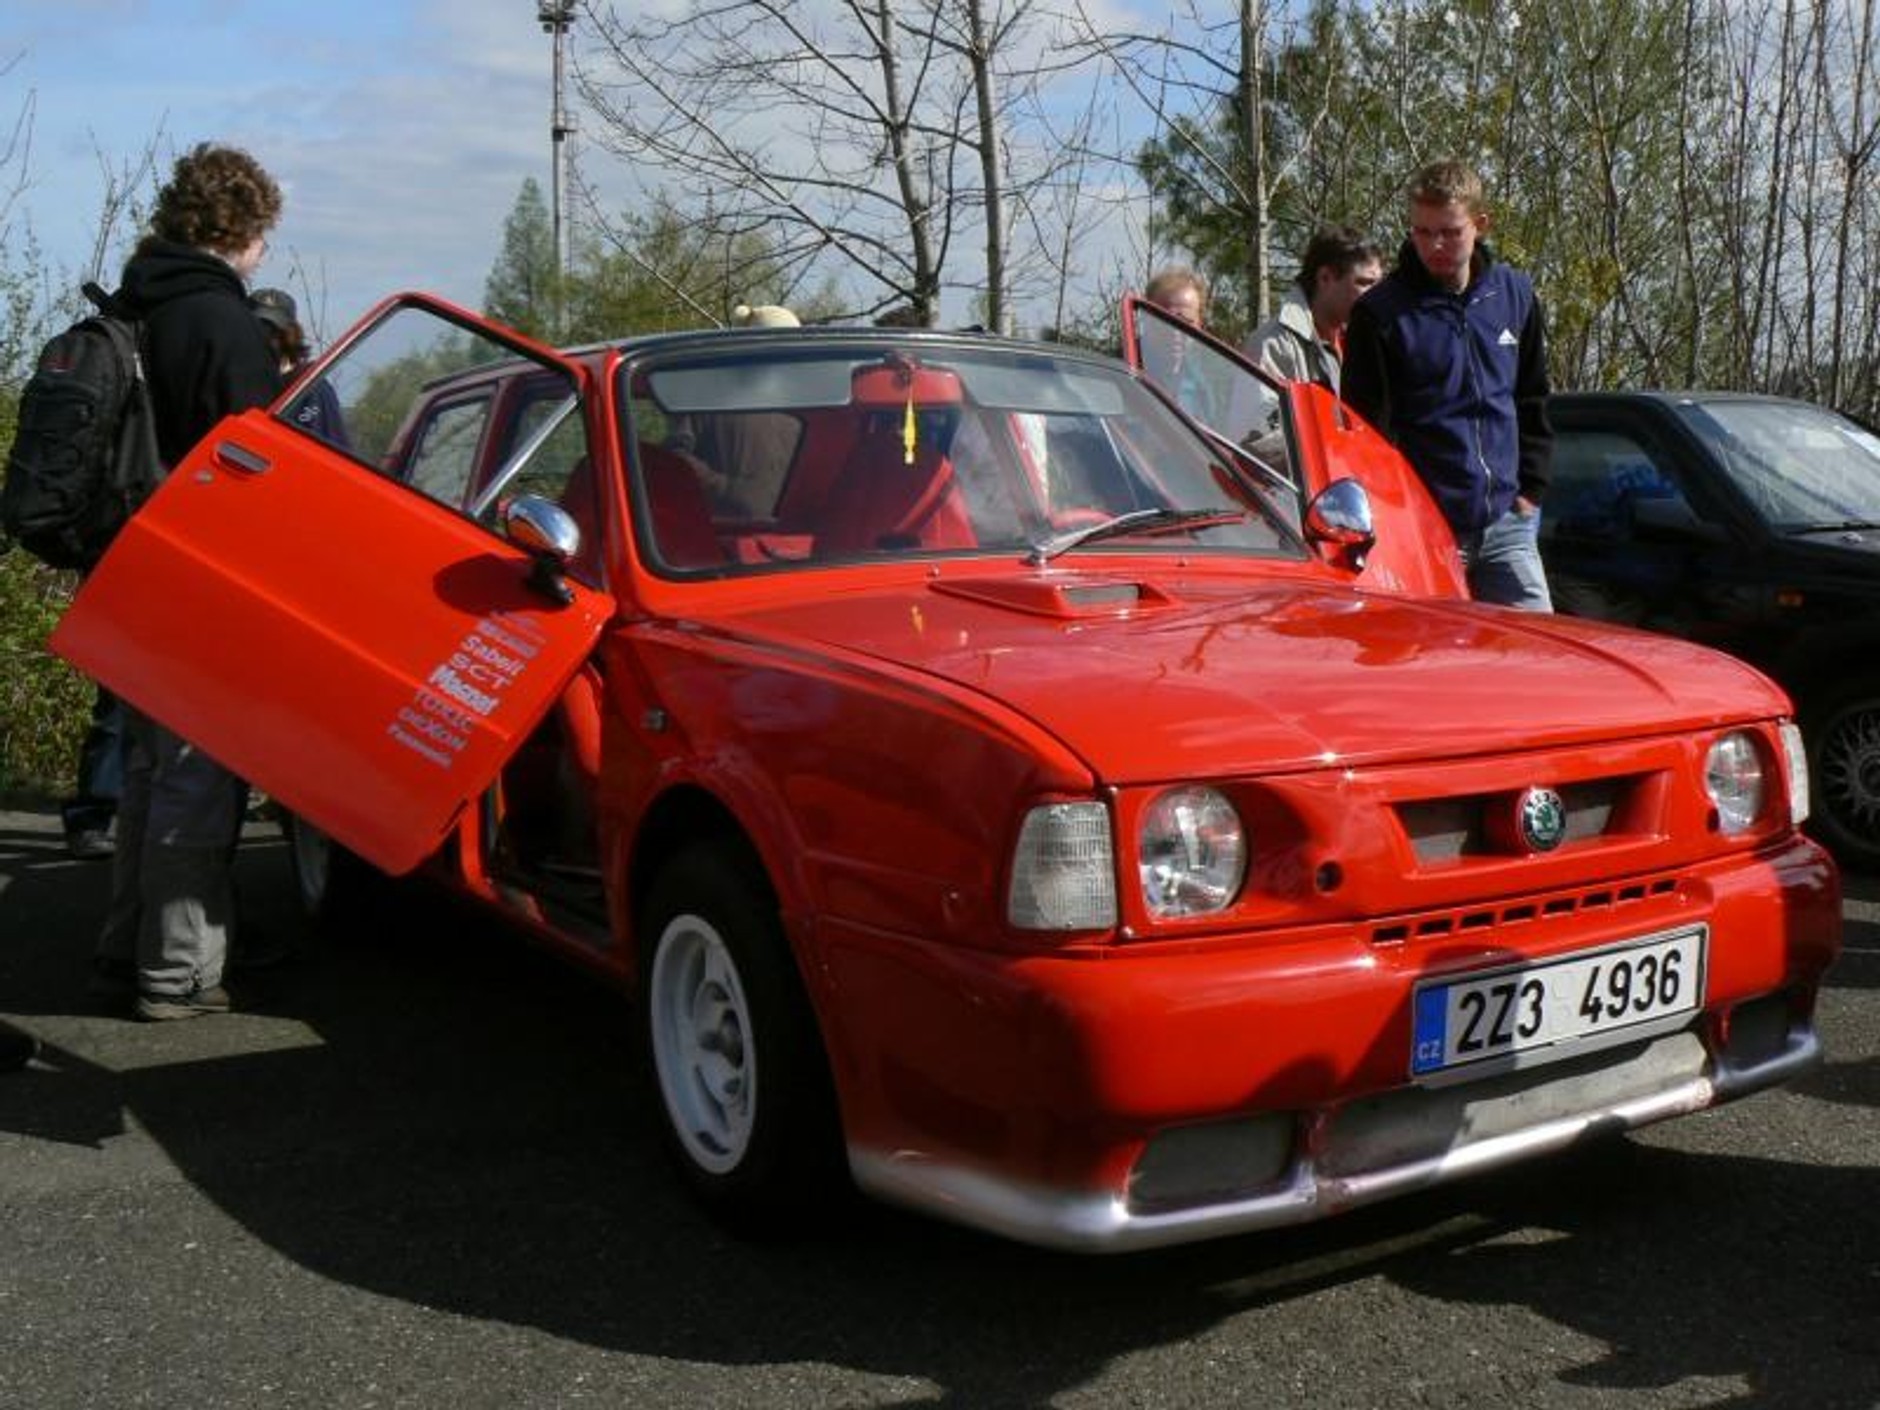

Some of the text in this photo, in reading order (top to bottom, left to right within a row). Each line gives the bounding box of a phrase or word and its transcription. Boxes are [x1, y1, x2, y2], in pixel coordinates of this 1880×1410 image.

[1456, 949, 1682, 1054] 2Z3 4936
[1417, 1040, 1440, 1060] CZ
